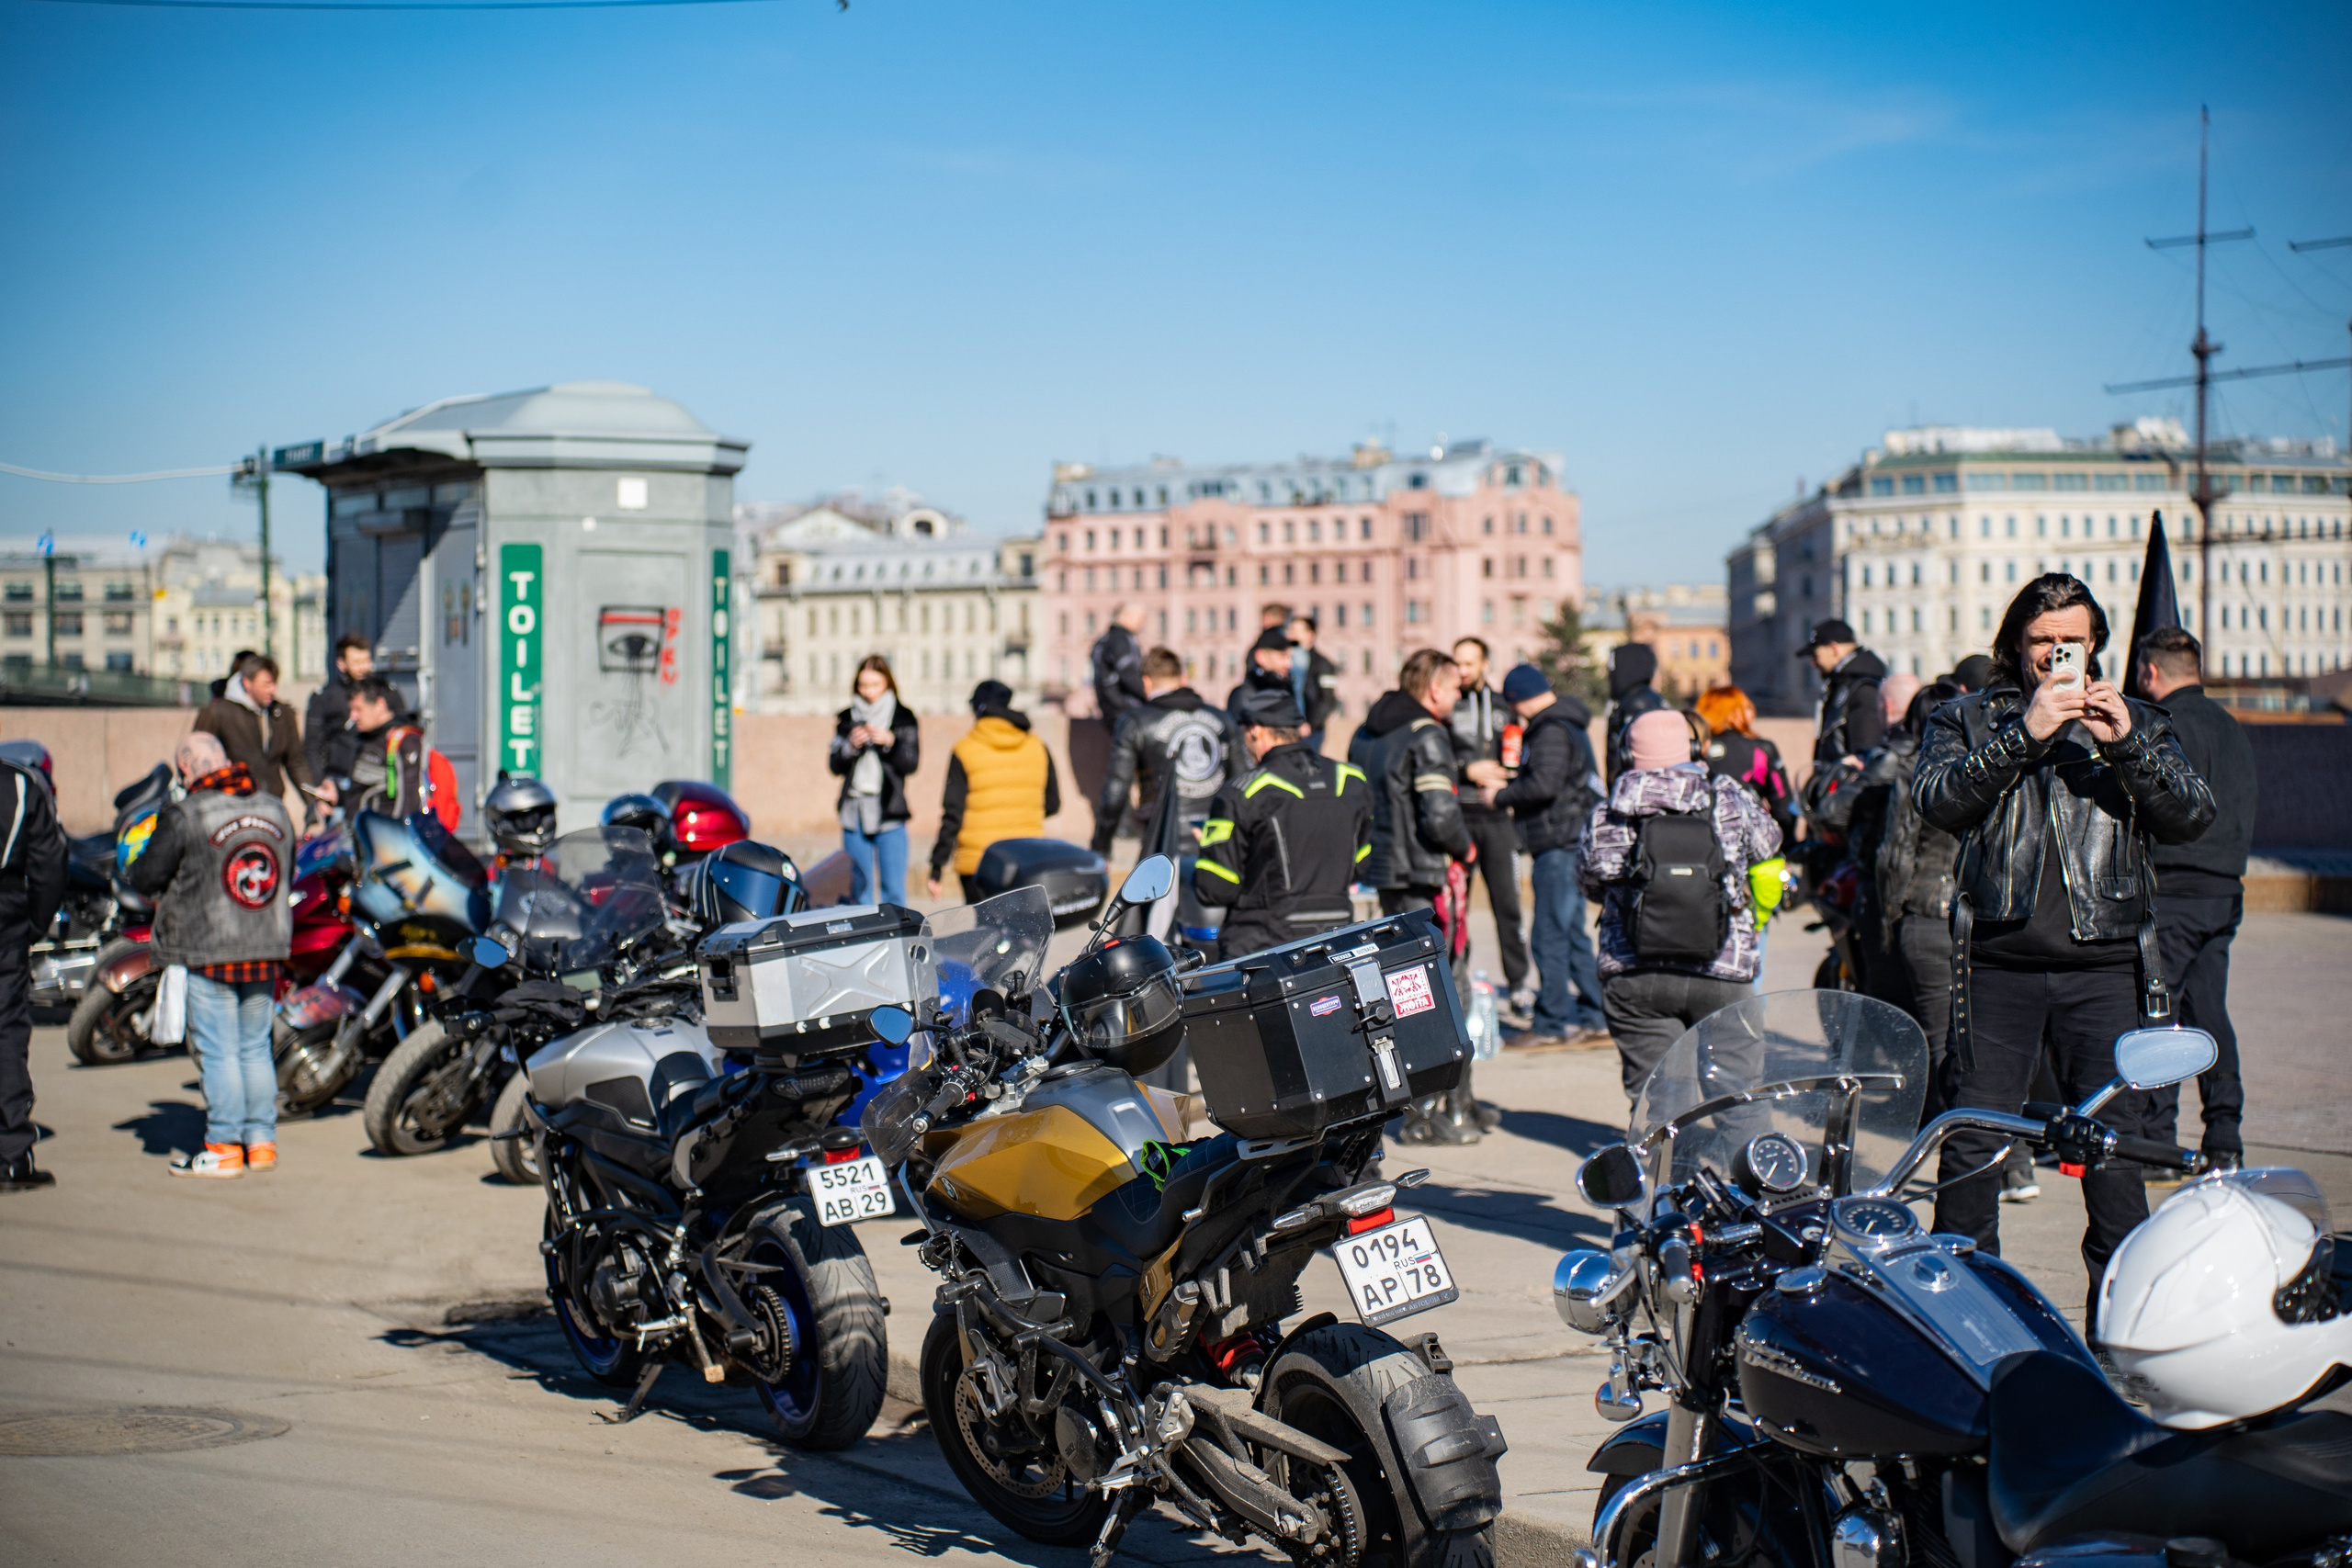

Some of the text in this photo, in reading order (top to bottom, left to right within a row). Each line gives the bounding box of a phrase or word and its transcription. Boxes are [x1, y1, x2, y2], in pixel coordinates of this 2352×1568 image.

[508, 570, 536, 769] TOILET
[713, 576, 729, 768] TOILET
[820, 1162, 875, 1189] 5521
[850, 1185, 867, 1194] RUS
[825, 1191, 887, 1222] AB 29
[1351, 1228, 1419, 1269] 0194
[1393, 1256, 1416, 1270] RUS
[1363, 1264, 1442, 1311] AP 78
